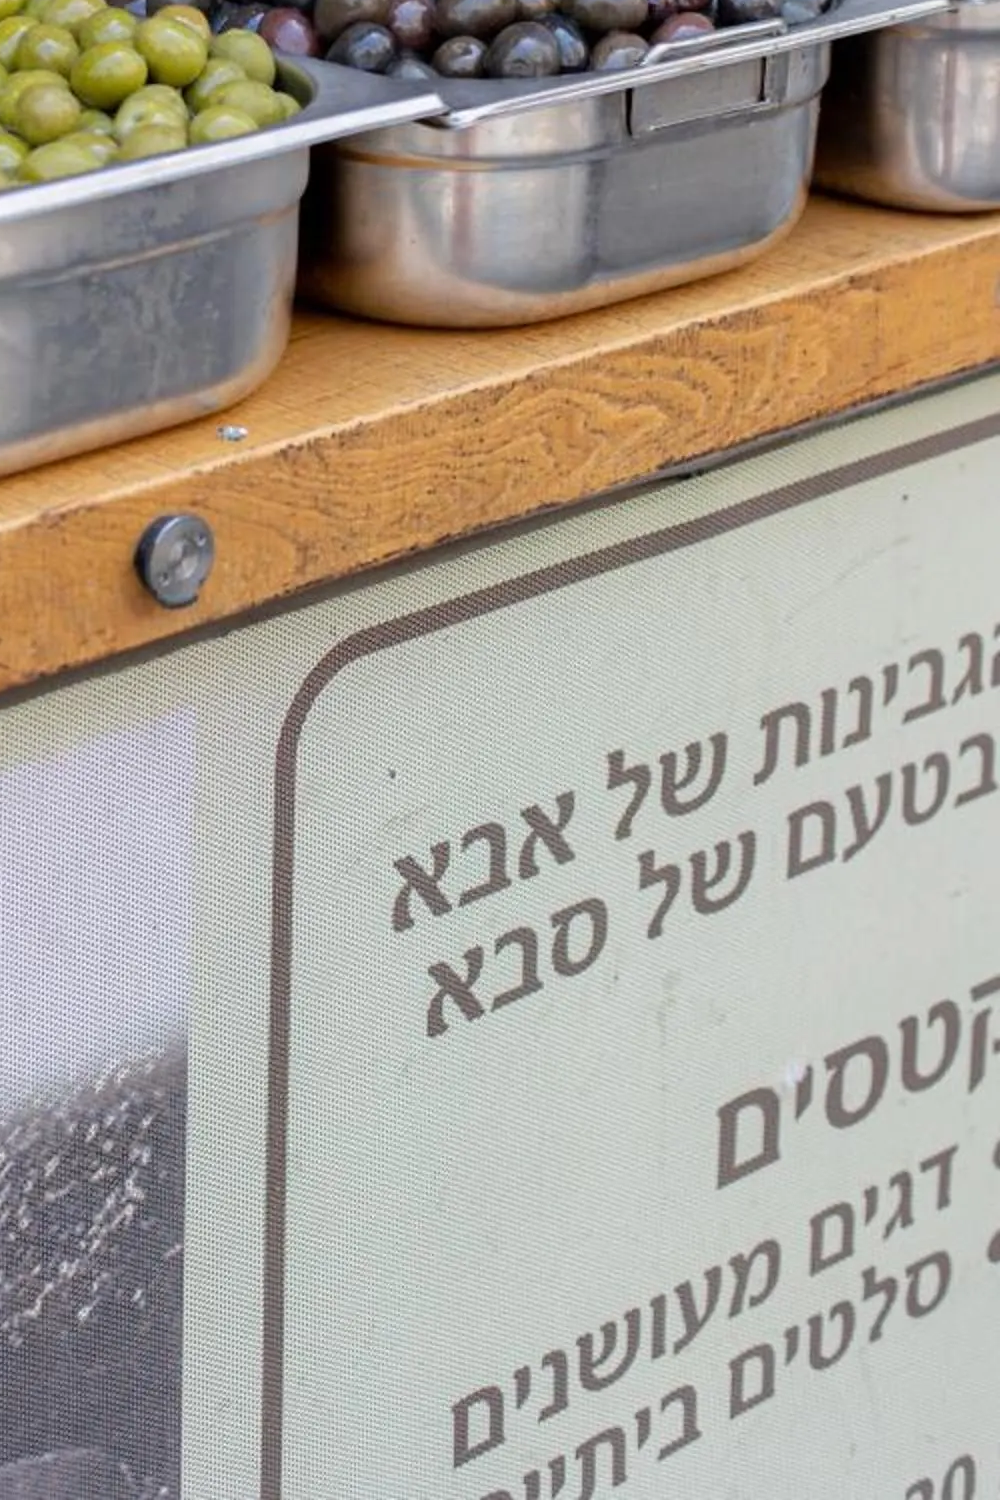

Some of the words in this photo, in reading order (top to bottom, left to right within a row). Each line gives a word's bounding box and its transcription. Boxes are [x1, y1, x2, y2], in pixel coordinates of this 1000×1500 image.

[753, 622, 1000, 787] גבינות
[606, 731, 728, 841] של
[787, 732, 998, 880] בטעם
[391, 790, 576, 933] אבא
[638, 830, 757, 940] של
[427, 897, 608, 1039] סבא
[809, 1145, 959, 1277] דגים
[451, 1238, 782, 1469] מעושנים
[728, 1250, 952, 1420] סלטים
[479, 1384, 702, 1500] ביתיי
